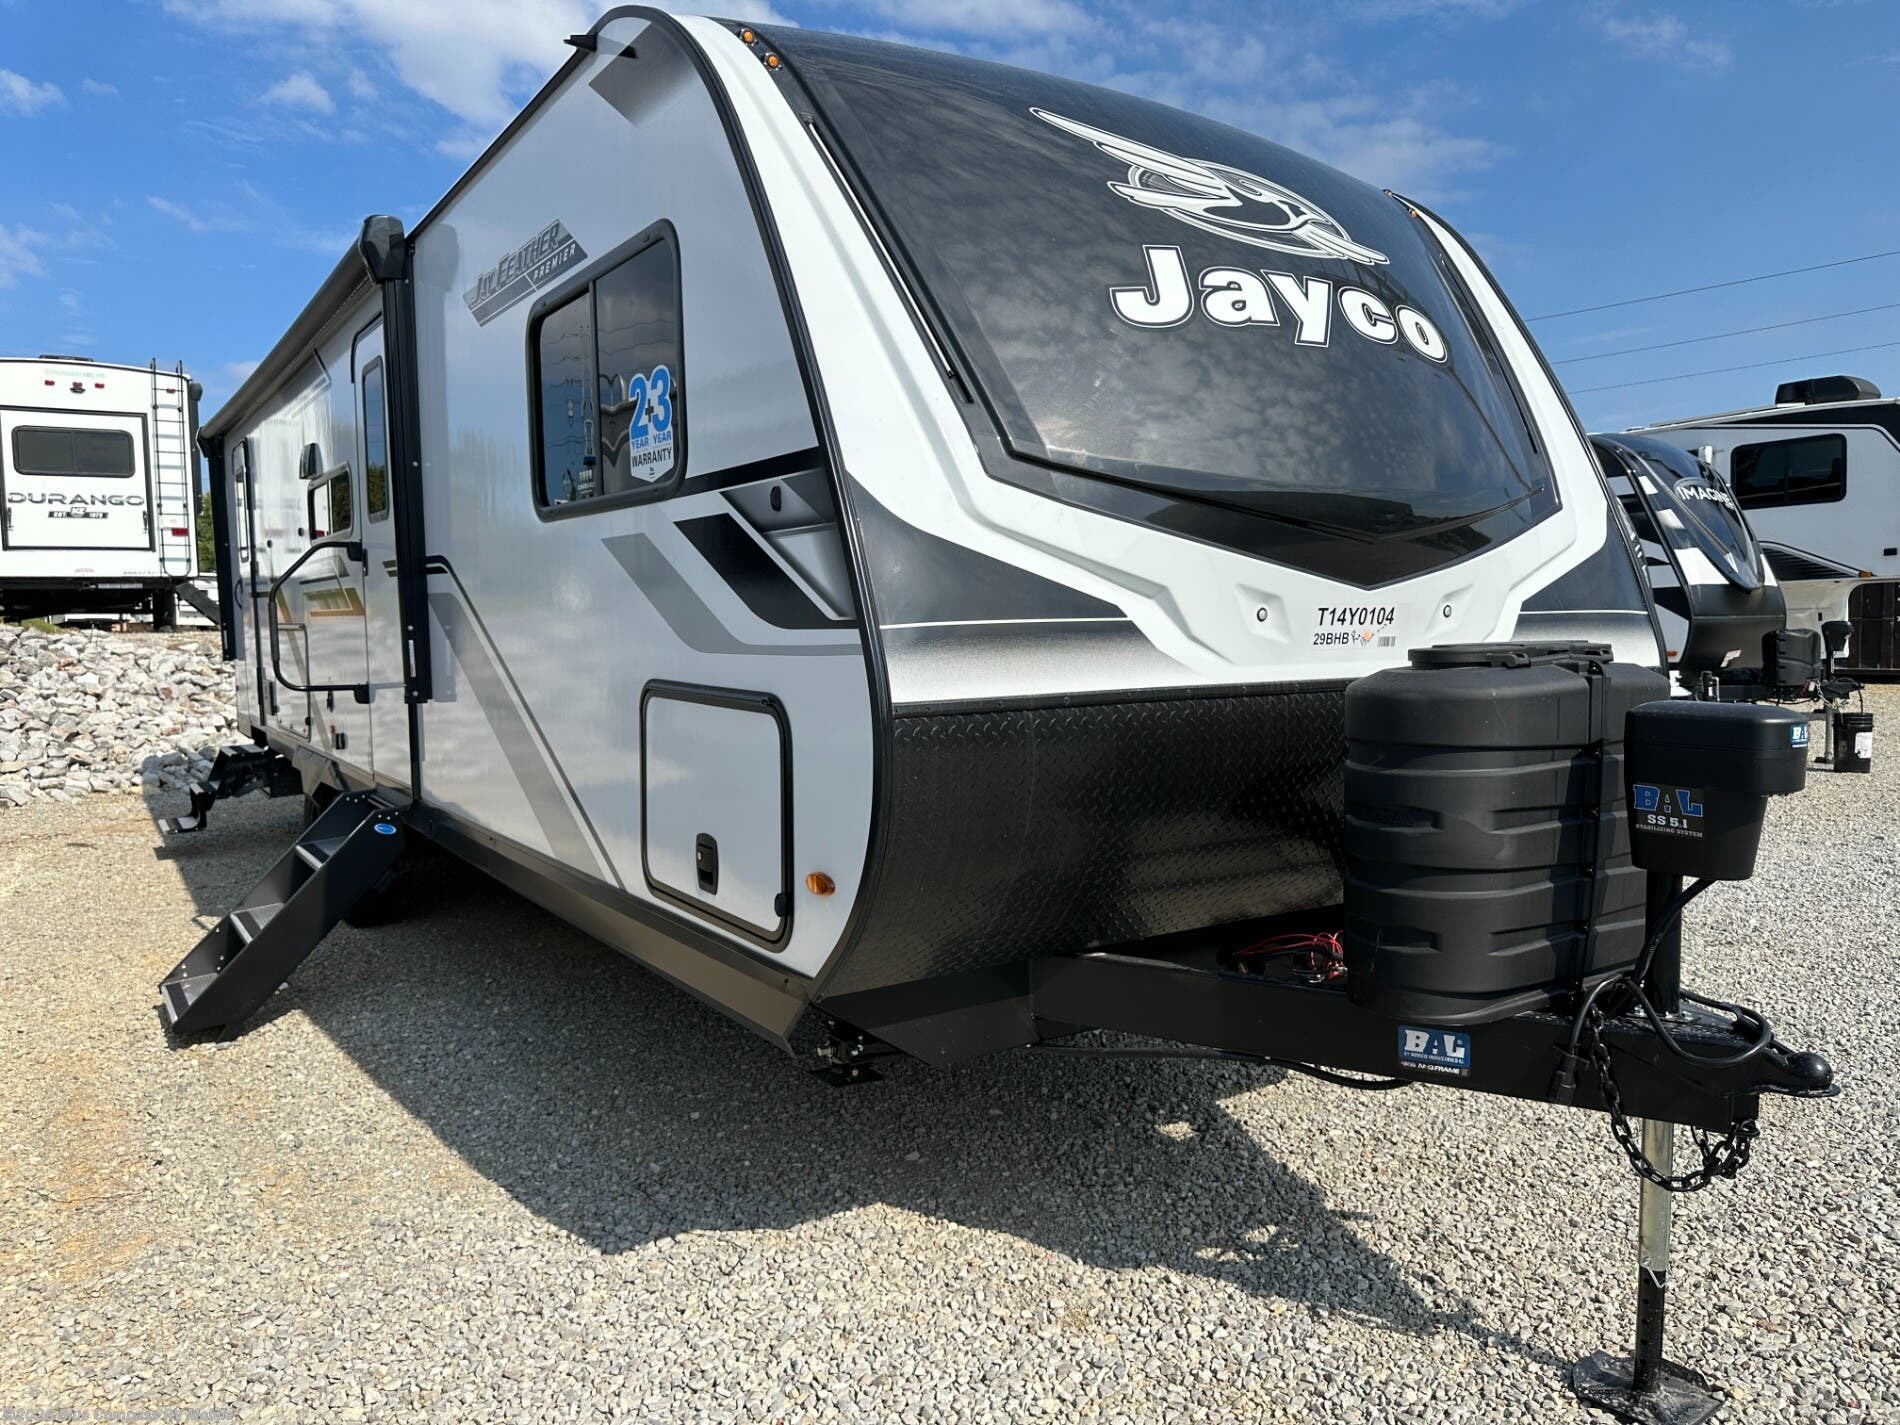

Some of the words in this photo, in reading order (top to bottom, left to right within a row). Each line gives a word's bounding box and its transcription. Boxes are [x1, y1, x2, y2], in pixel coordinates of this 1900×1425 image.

[495, 221, 560, 289] FEATHER
[532, 242, 576, 283] PREMIER
[1109, 244, 1448, 363] Jayco
[631, 437, 650, 450] YEAR
[653, 431, 672, 445] YEAR
[631, 447, 672, 468] WARRANTY
[7, 492, 145, 507] DURANGO
[1317, 606, 1396, 626] T14Y0104
[1312, 632, 1350, 646] 29BHB
[1632, 783, 1704, 818] BAL
[1635, 823, 1676, 834] STABILIZING
[1676, 829, 1704, 838] SYSTEM
[1647, 813, 1667, 826] SS
[1669, 817, 1688, 829] 5.1
[1404, 1029, 1466, 1059] BAL
